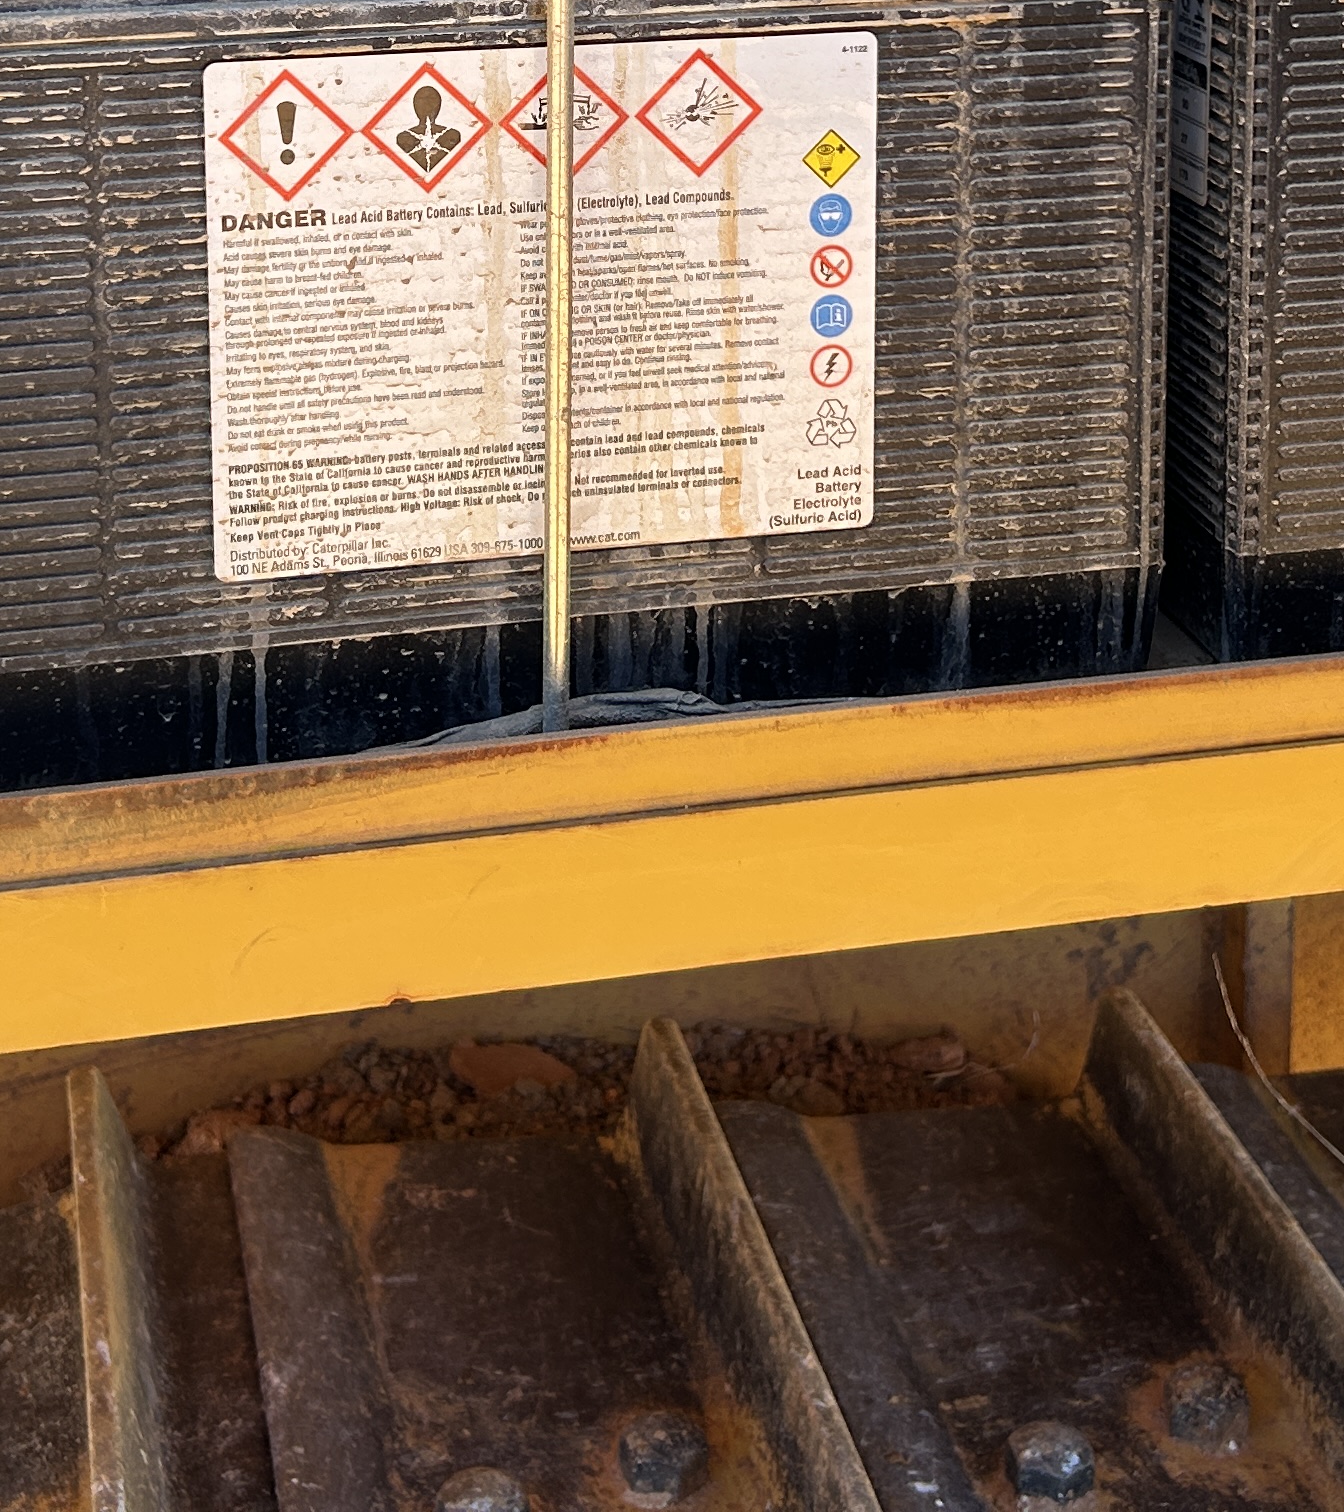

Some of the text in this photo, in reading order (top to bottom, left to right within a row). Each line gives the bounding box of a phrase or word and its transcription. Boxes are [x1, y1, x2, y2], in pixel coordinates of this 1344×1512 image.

[219, 210, 327, 231] DANGER
[331, 211, 357, 223] Lead
[360, 210, 382, 222] Acid
[386, 207, 423, 222] Battery
[477, 202, 506, 216] Lead,
[577, 194, 642, 210] (Electrolyte),
[645, 193, 670, 204] Lead
[673, 189, 734, 204] Compounds.
